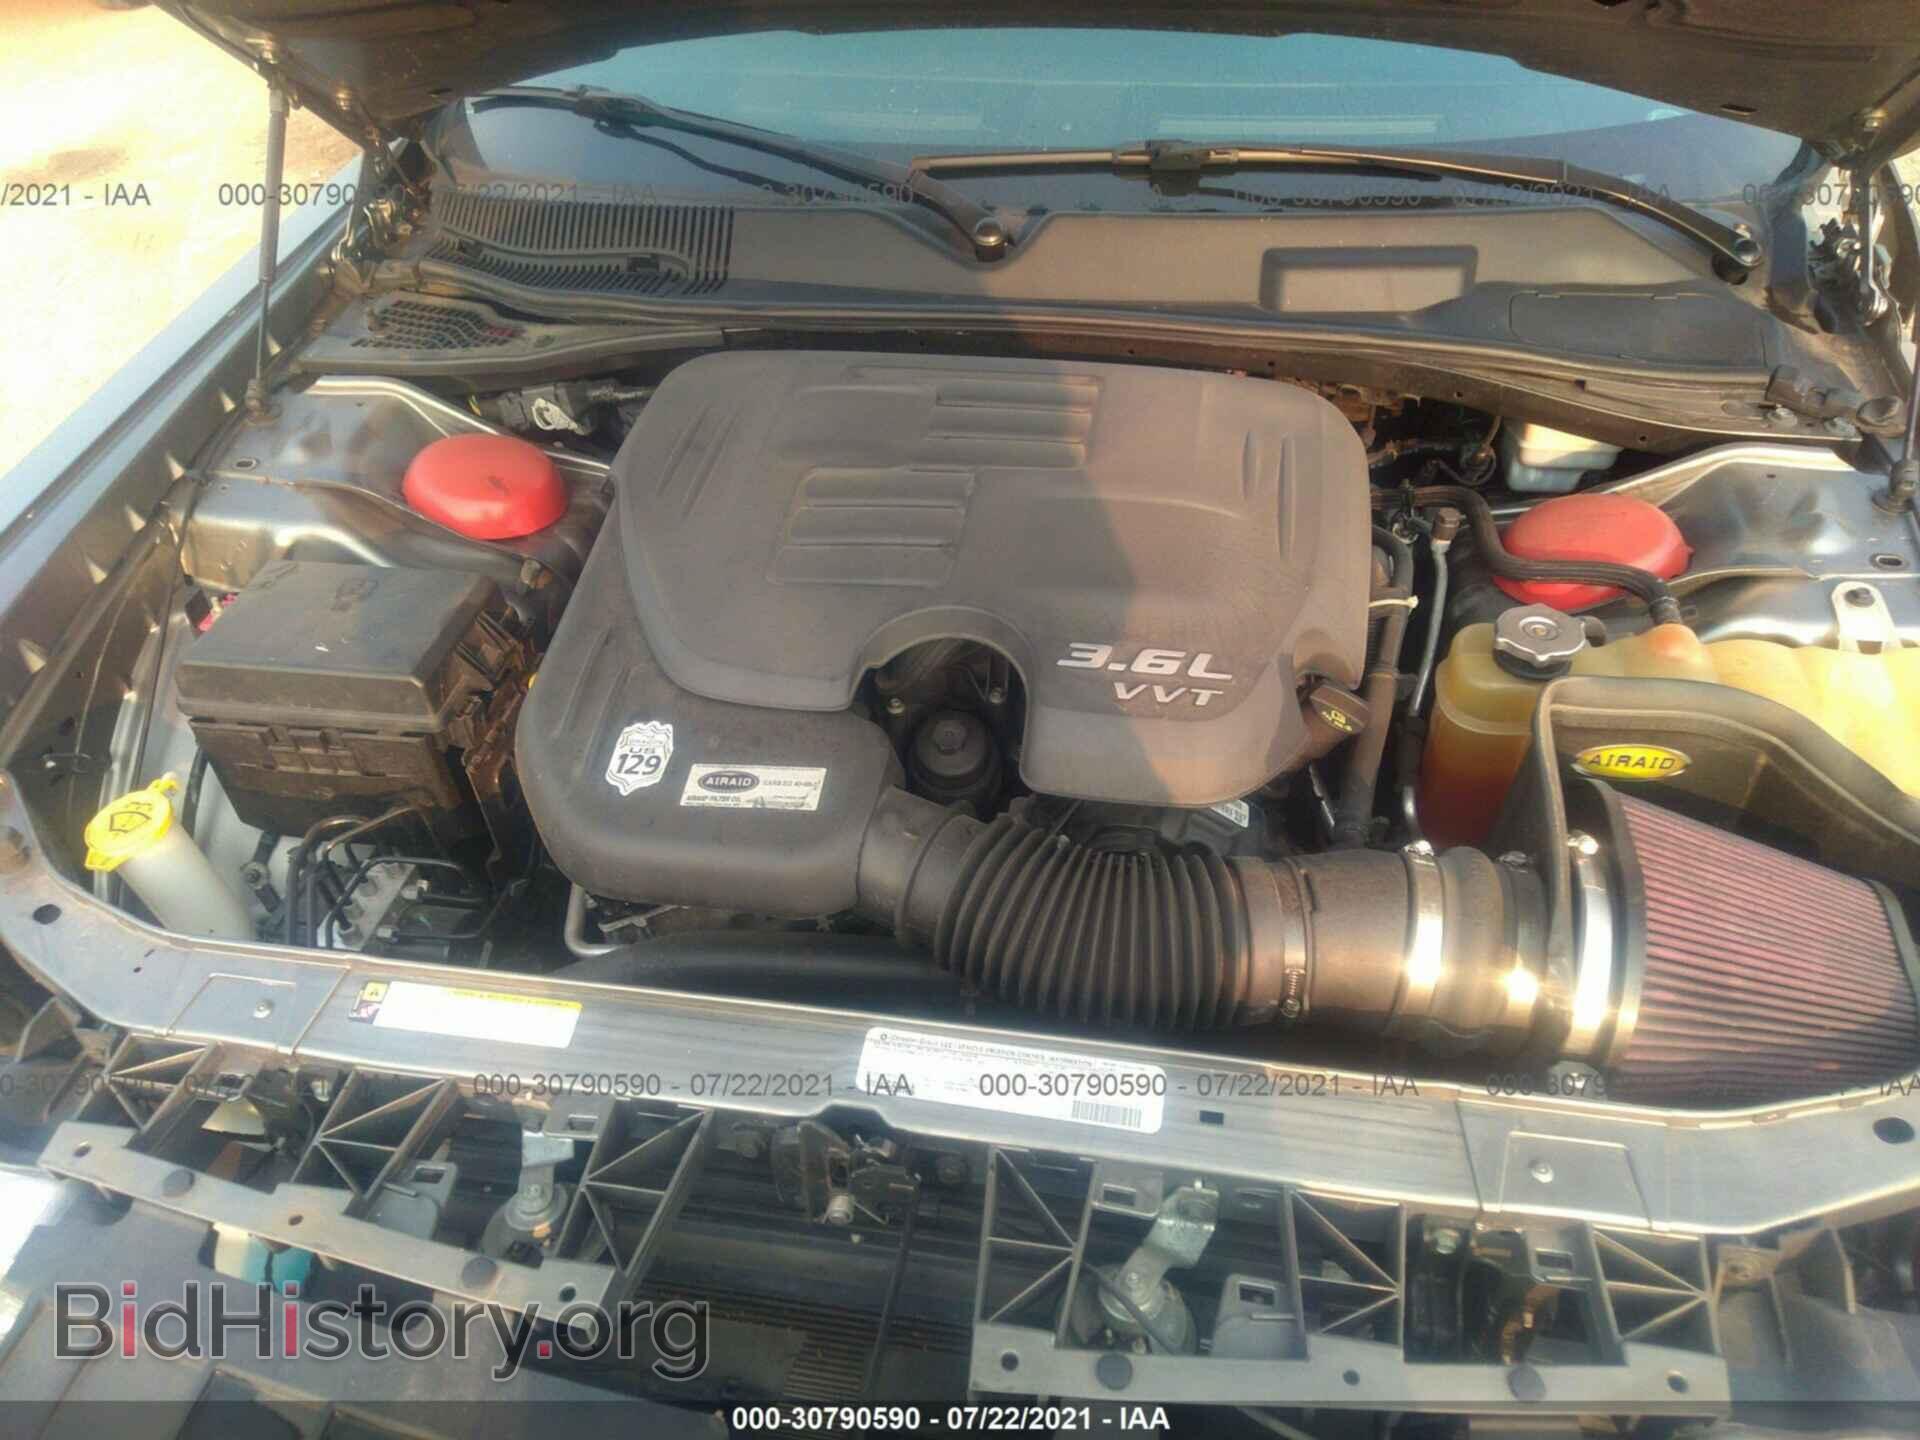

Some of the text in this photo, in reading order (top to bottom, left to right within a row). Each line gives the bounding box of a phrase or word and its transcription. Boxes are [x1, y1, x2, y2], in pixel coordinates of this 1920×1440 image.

[1057, 642, 1233, 680] 3.6L
[1113, 682, 1224, 706] VVT
[616, 753, 662, 775] 129
[1588, 754, 1676, 770] AIRAID
[705, 776, 752, 786] AIRAID
